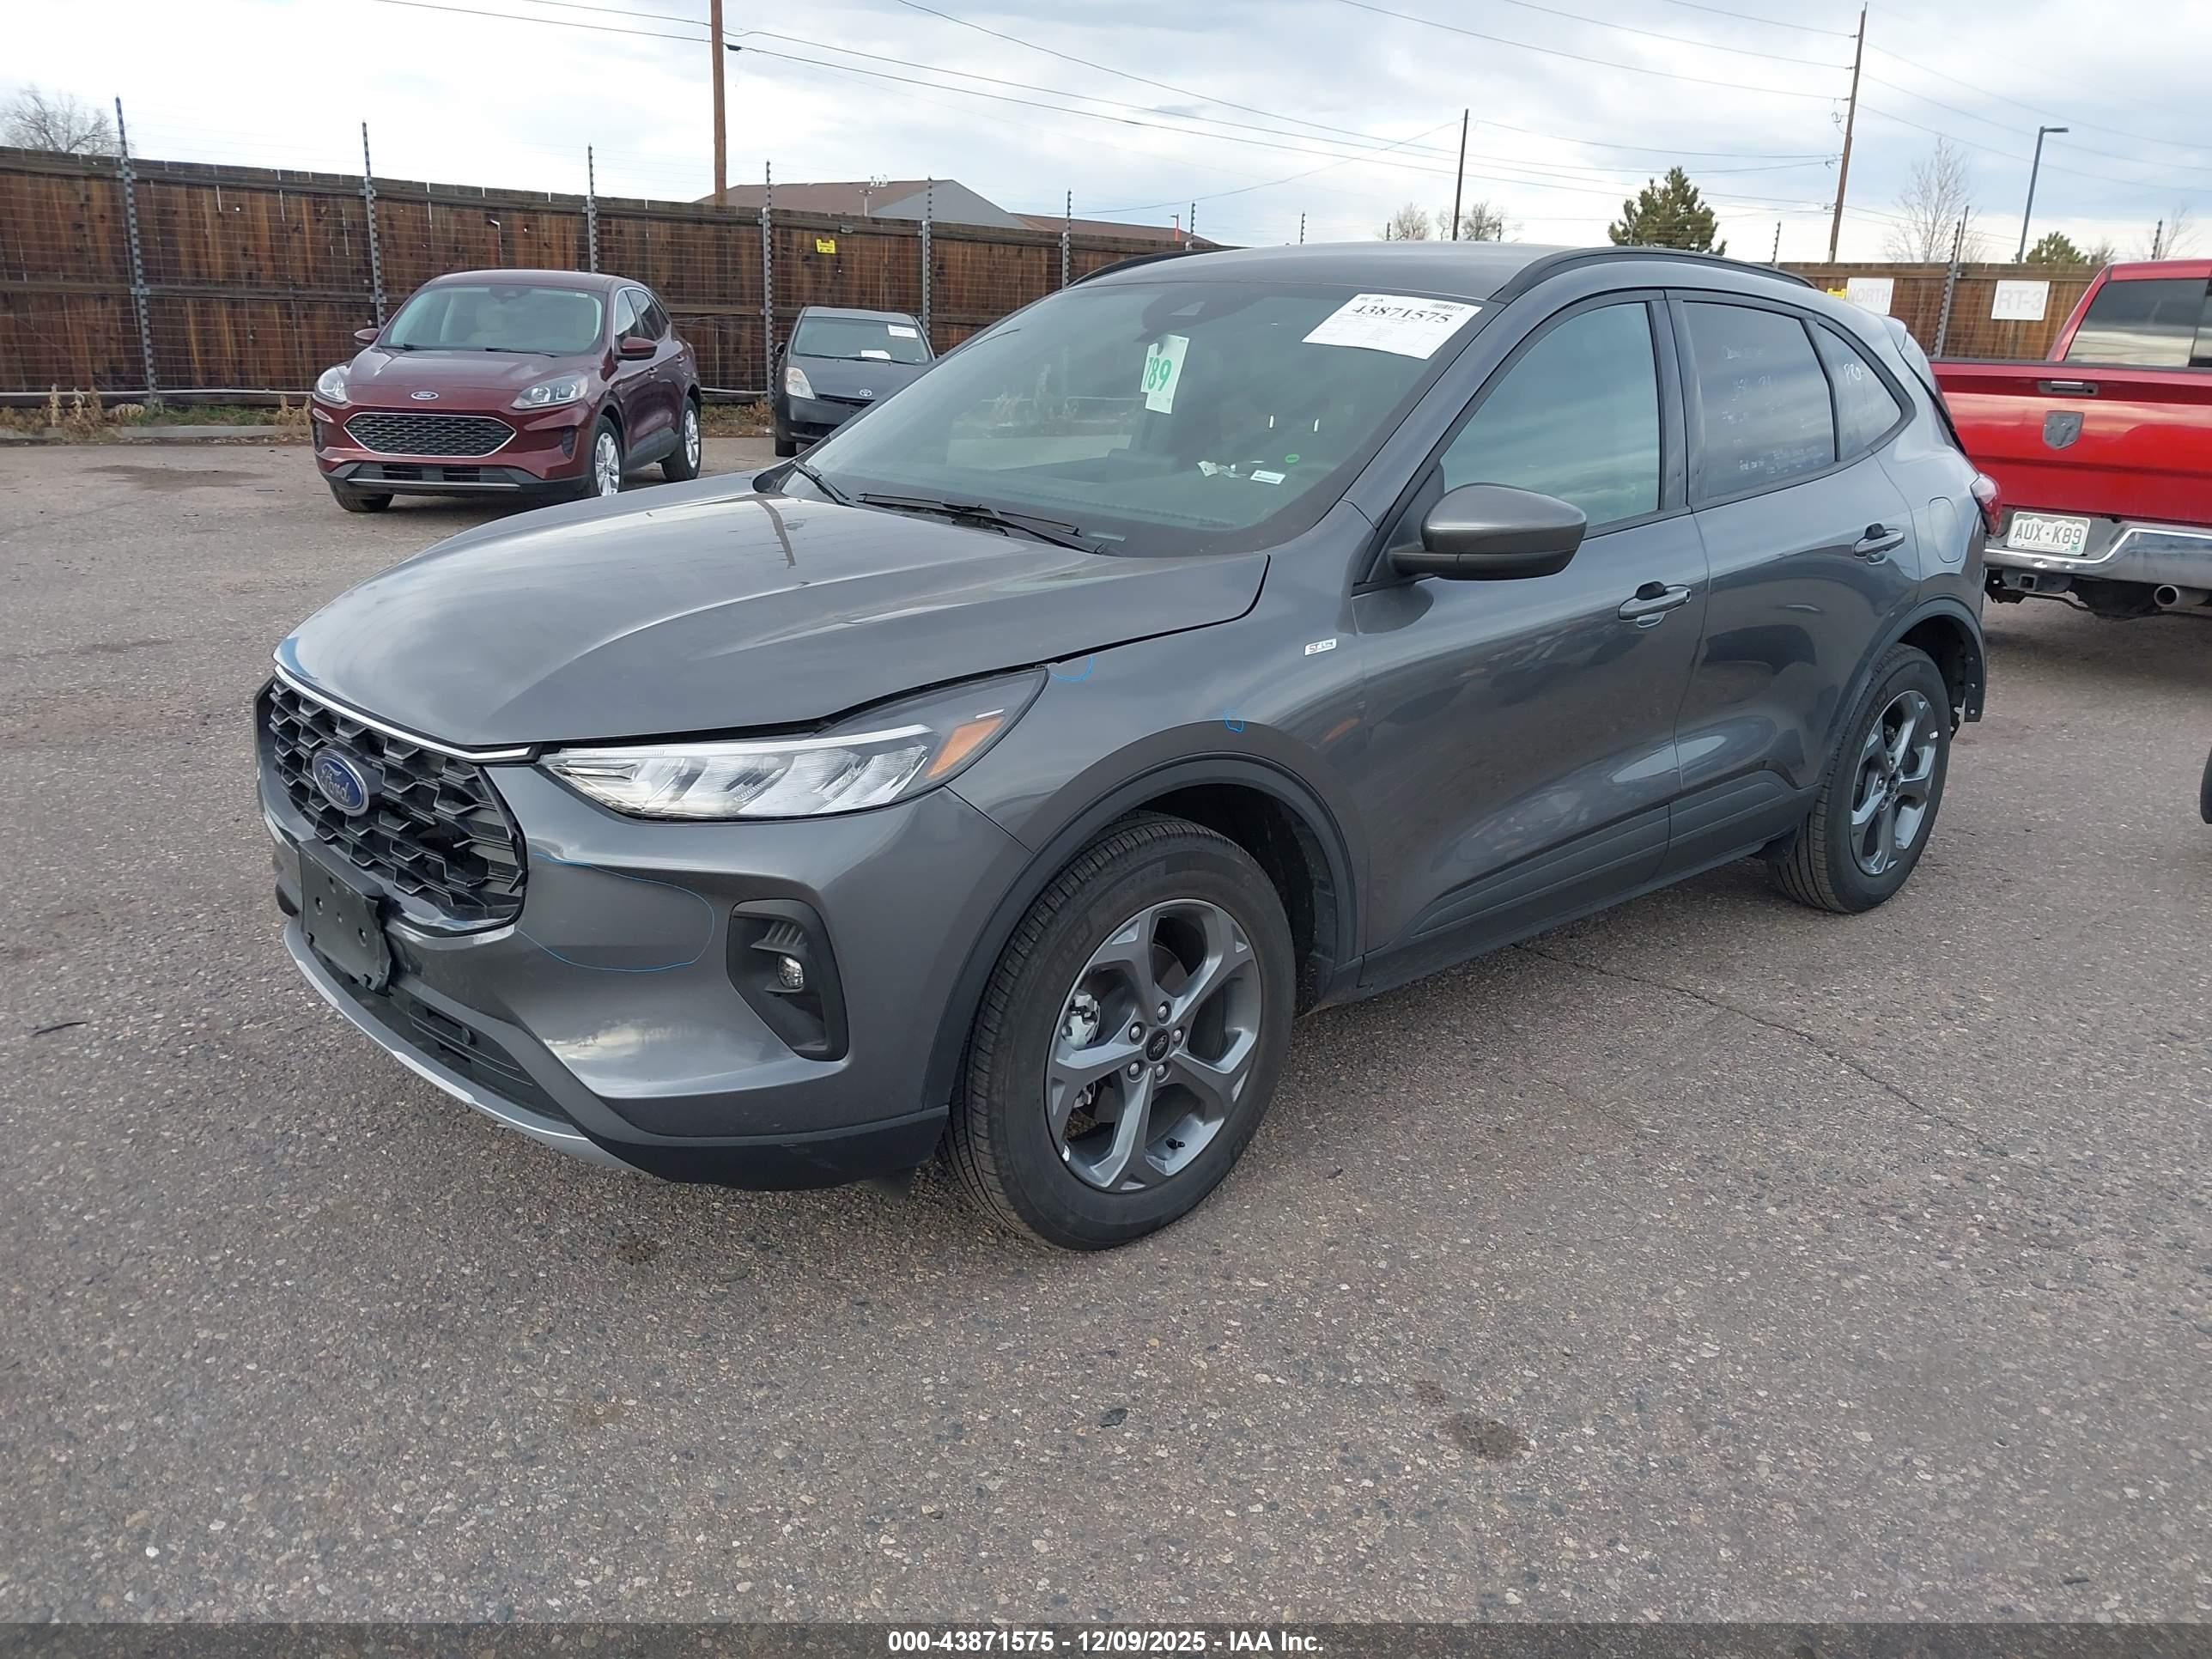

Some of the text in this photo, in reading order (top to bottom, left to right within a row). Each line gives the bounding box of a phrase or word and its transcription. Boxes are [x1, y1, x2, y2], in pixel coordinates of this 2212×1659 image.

[1847, 288, 1891, 303] NORTH
[1997, 289, 2044, 310] RT-3
[1352, 305, 1453, 324] 43871575
